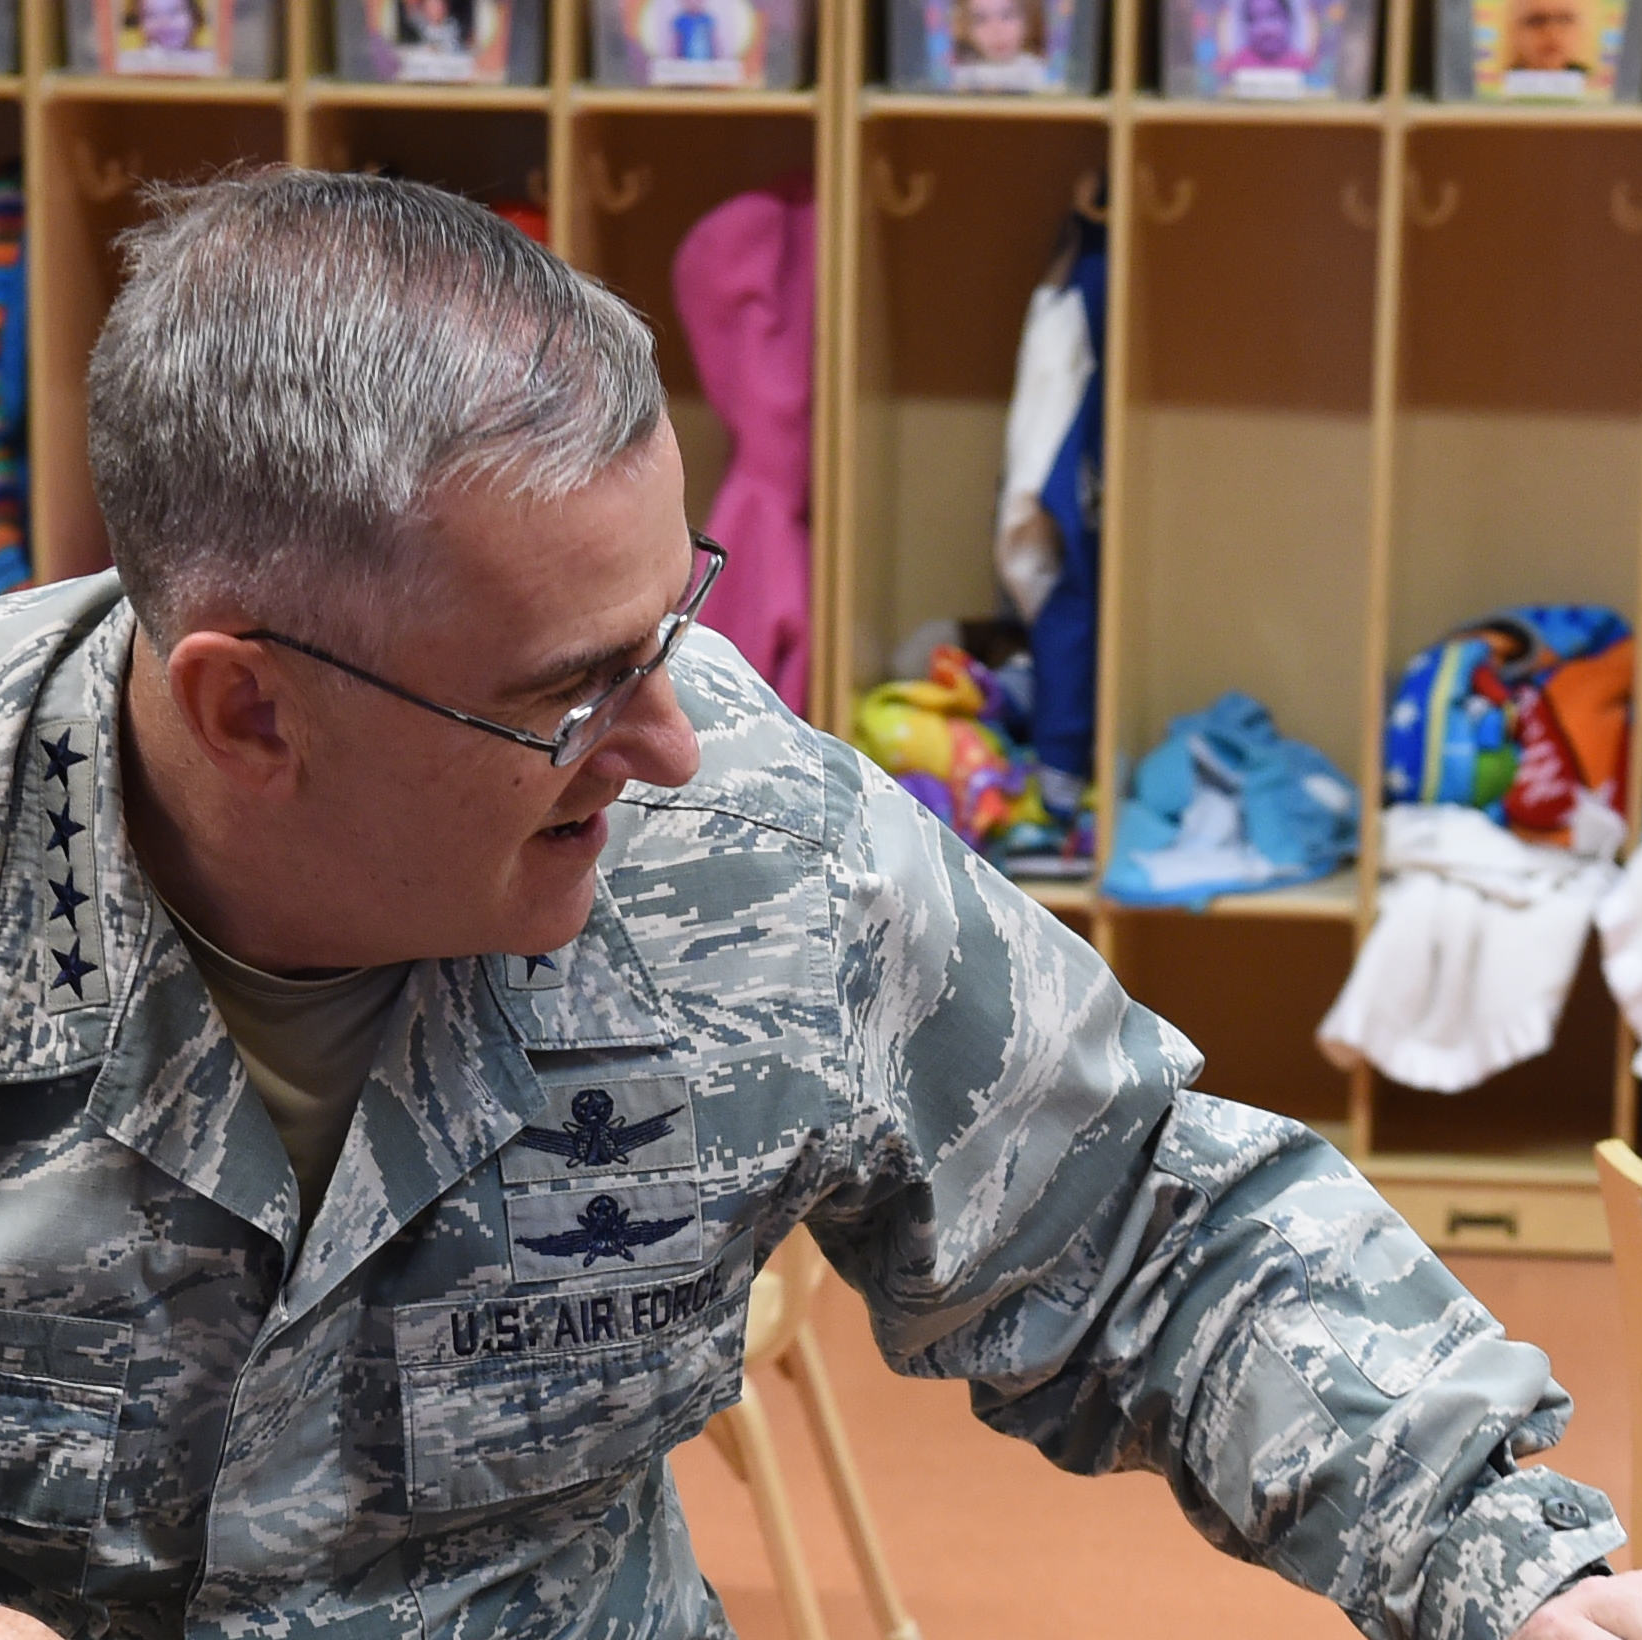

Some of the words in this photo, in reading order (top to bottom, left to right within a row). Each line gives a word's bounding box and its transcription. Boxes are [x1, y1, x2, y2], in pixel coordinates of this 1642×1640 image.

[451, 1306, 538, 1357] U.S.
[554, 1297, 616, 1345] AIR
[631, 1264, 724, 1336] FORCE
